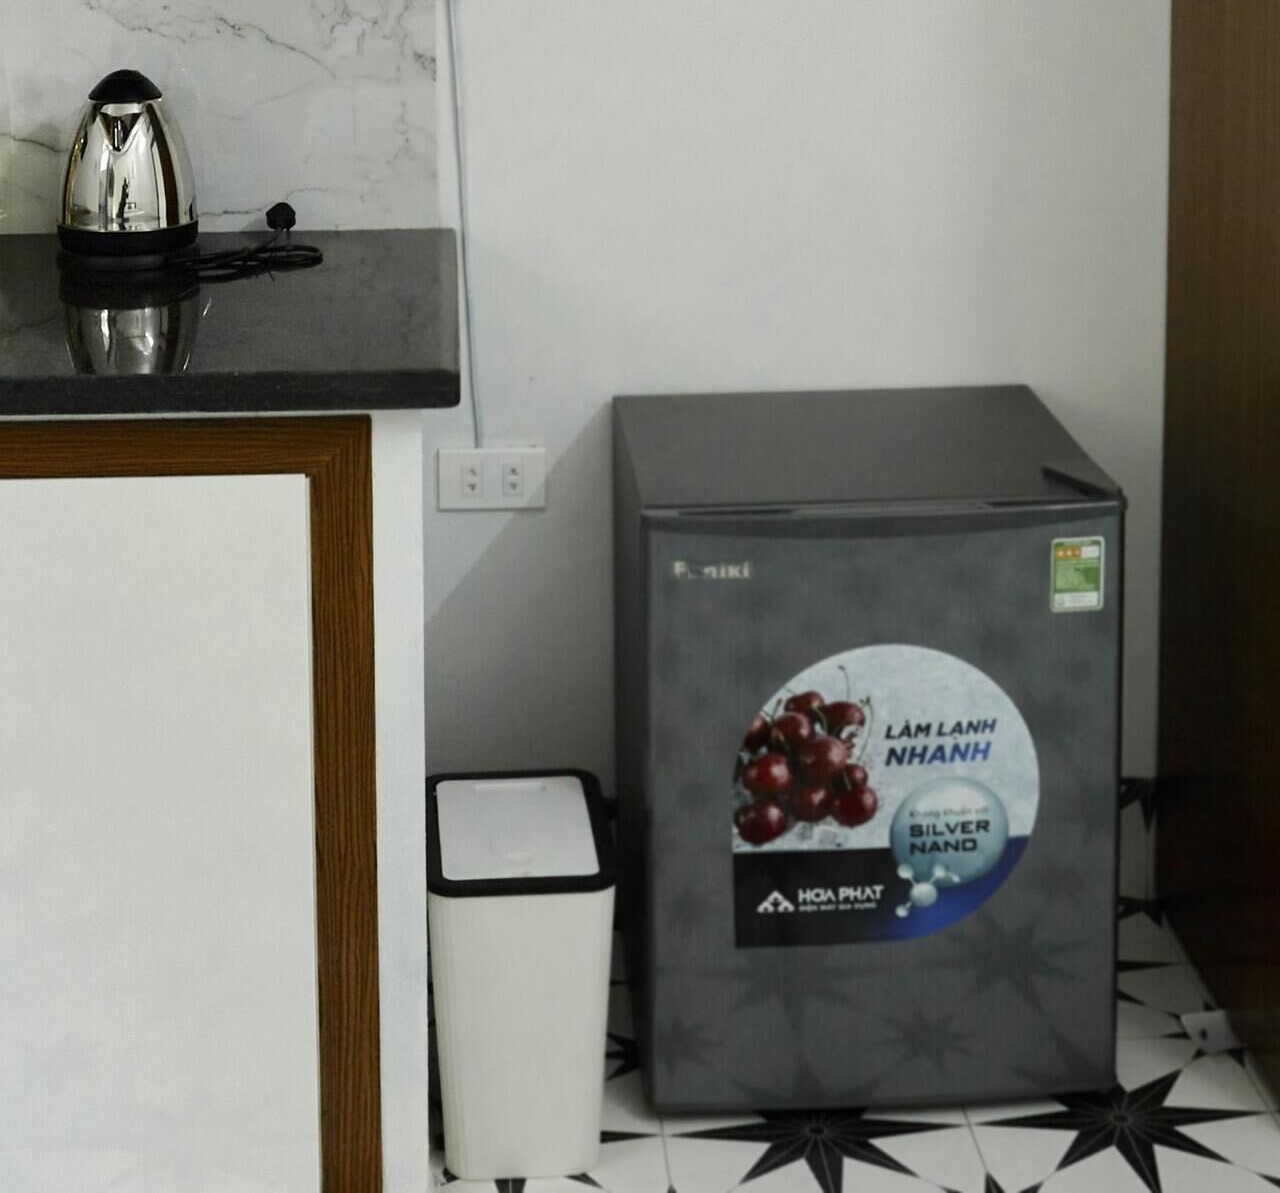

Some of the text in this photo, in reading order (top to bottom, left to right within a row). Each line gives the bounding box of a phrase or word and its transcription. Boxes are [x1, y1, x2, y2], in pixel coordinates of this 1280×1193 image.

[885, 741, 992, 767] NHANH
[909, 819, 990, 838] SILVER
[909, 838, 978, 856] NANO
